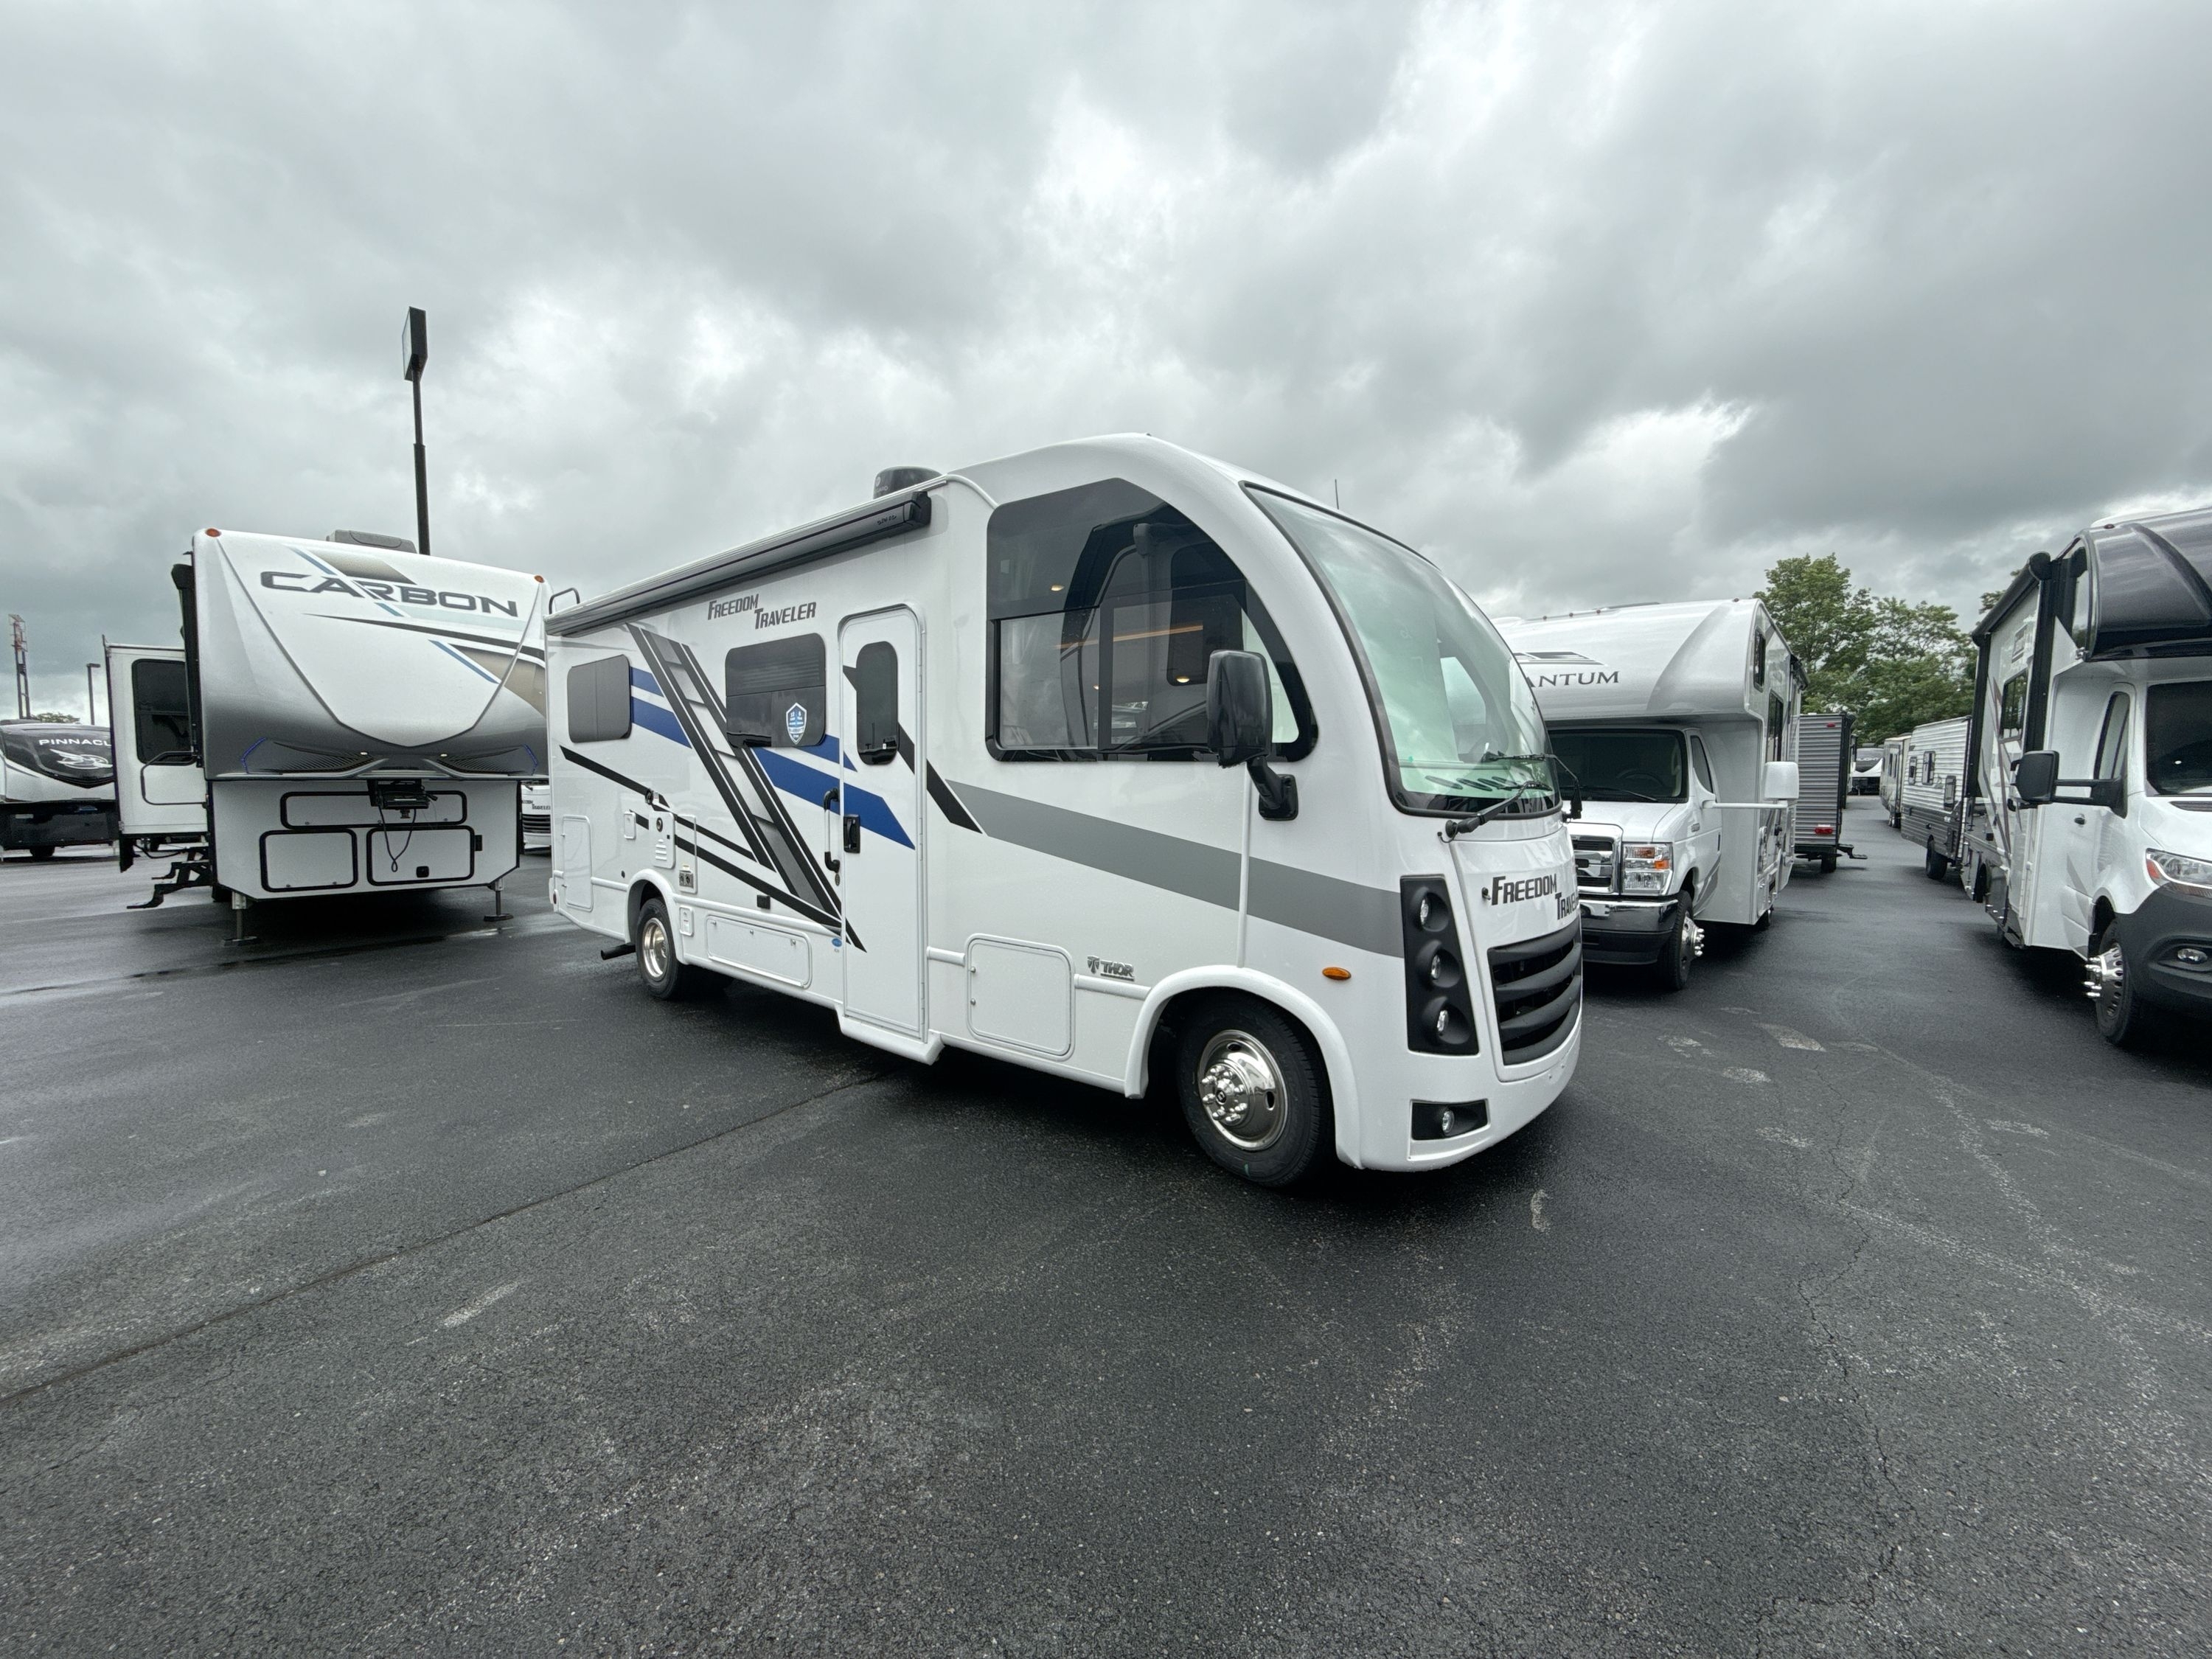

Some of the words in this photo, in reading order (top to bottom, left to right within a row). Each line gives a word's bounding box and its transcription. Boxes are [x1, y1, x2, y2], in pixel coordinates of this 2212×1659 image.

[260, 571, 518, 618] CARBON
[708, 594, 759, 621] FREEDOM
[754, 602, 817, 630] TRAVELER
[1492, 873, 1557, 906] FREEDOM
[1100, 960, 1134, 977] THOR
